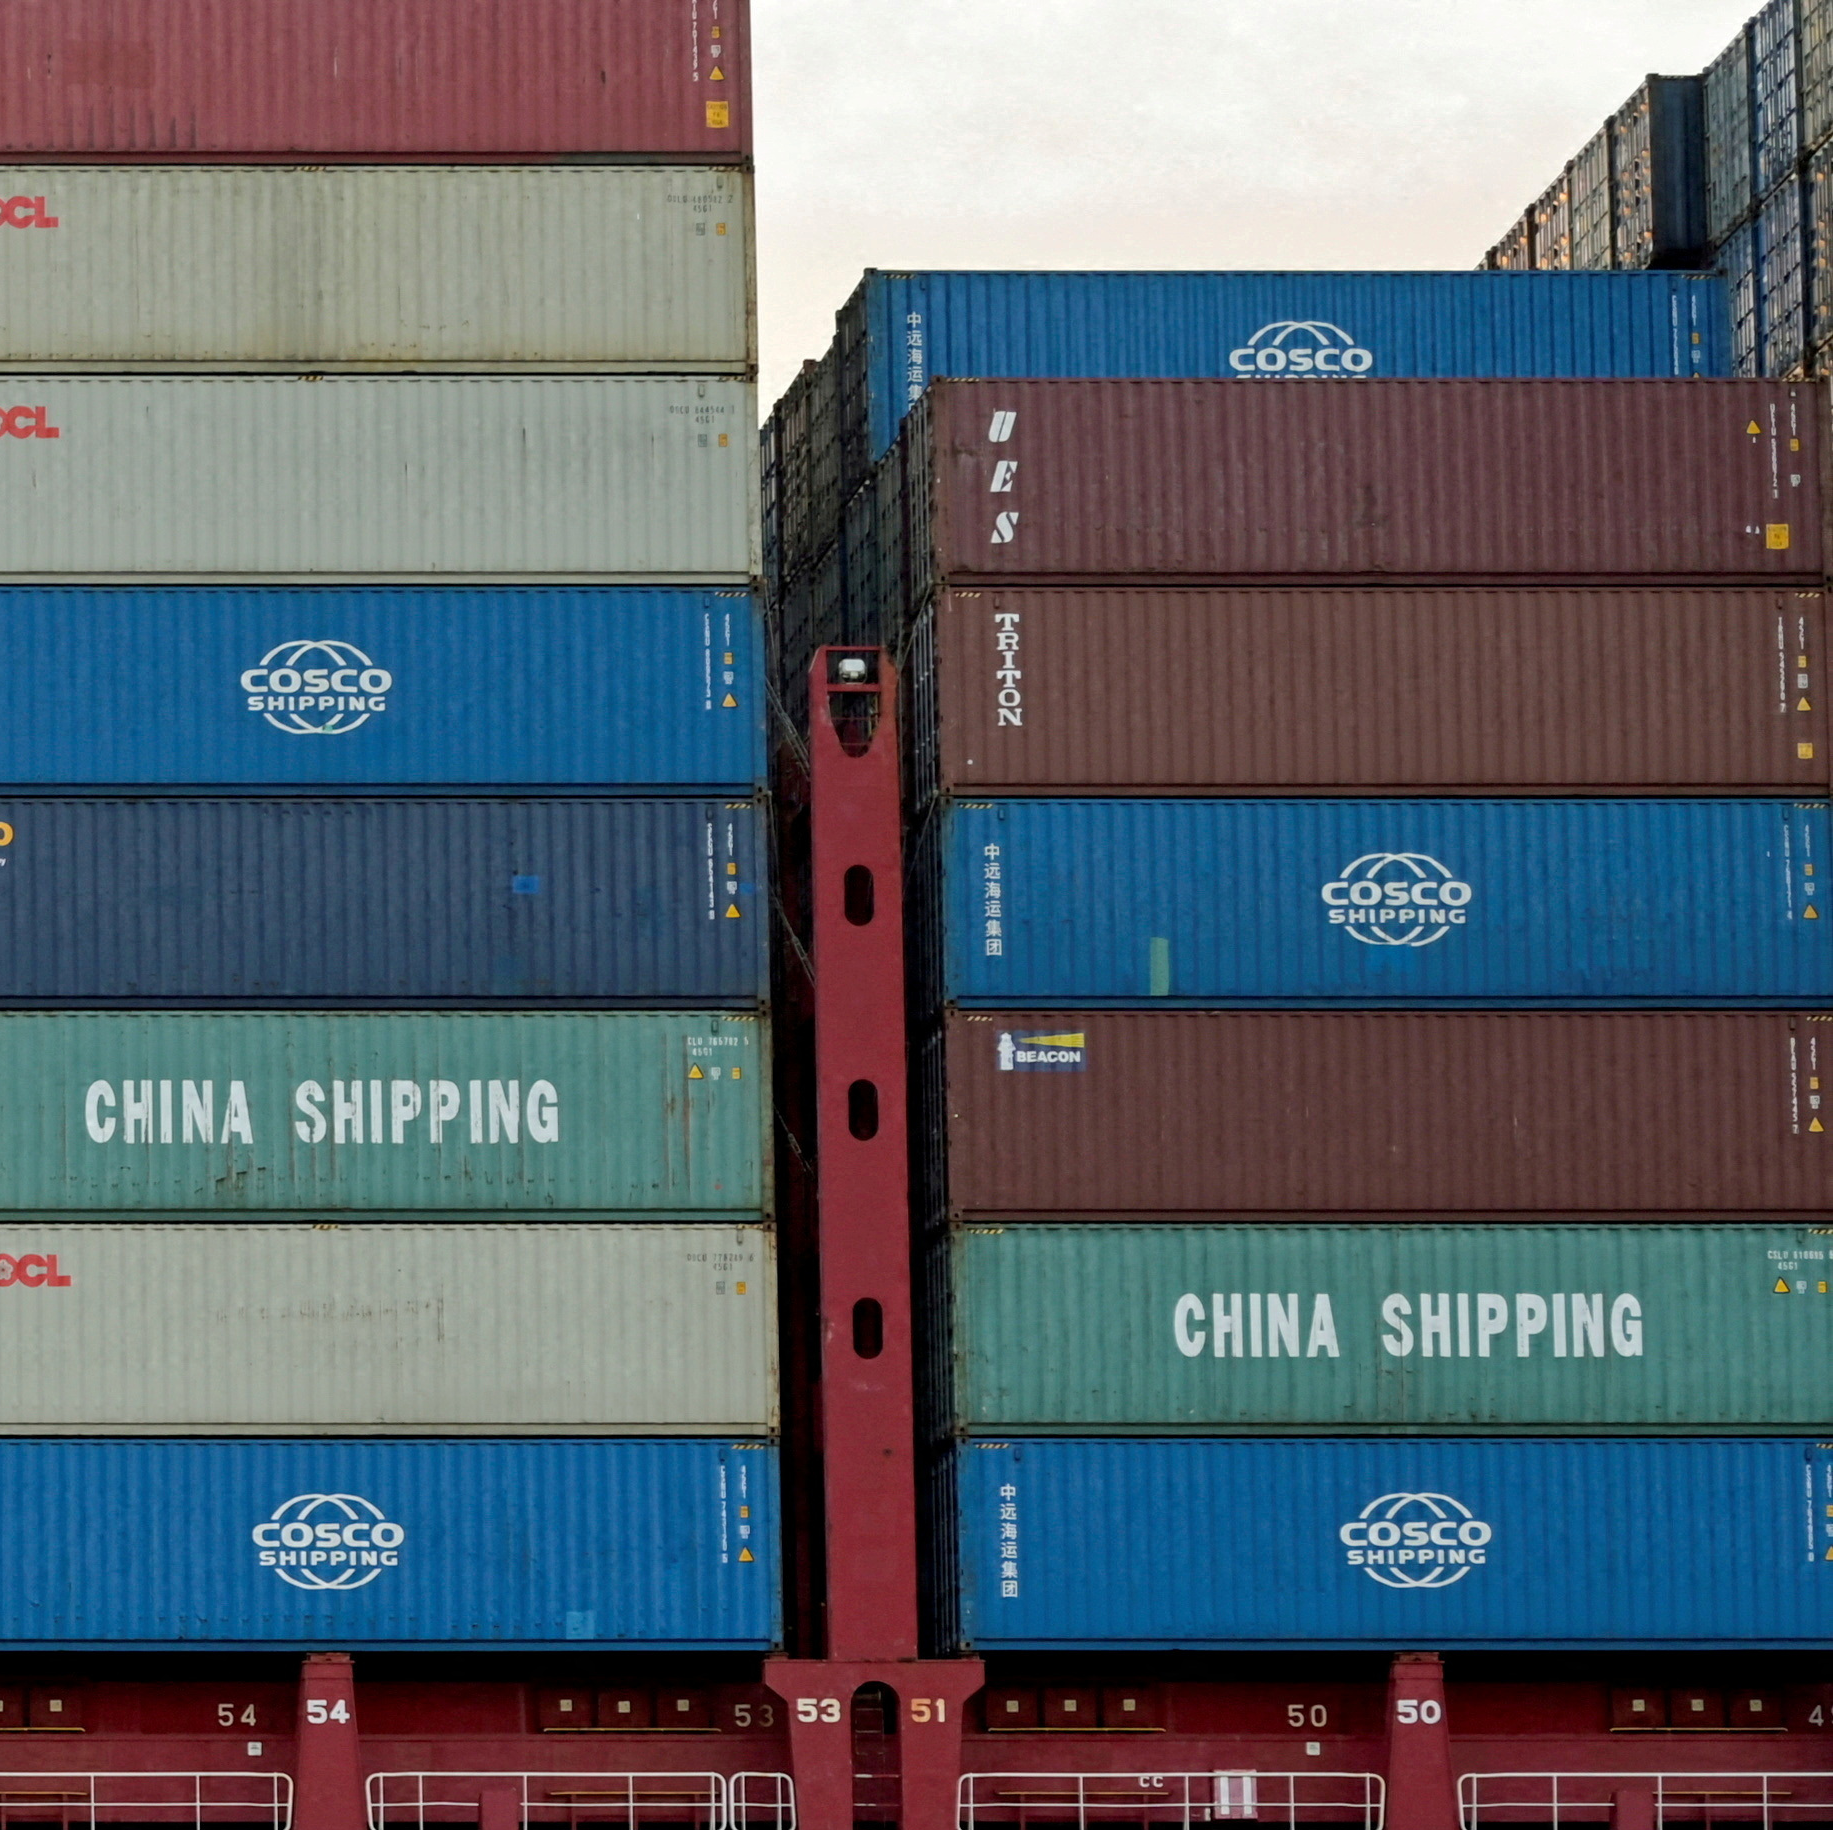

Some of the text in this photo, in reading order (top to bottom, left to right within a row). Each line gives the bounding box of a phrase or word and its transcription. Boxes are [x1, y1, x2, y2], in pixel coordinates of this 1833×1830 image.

[906, 312, 924, 411] 中远海运集
[1230, 348, 1372, 372] COSCO
[241, 668, 392, 694] COSCO
[995, 614, 1022, 725] TRITON
[248, 696, 386, 712] SHIPPING
[985, 843, 1001, 955] 中远海运集团
[1322, 881, 1471, 906] COSCO
[1329, 909, 1466, 924] SHIPPING
[1016, 1050, 1081, 1063] BEACON
[86, 1080, 558, 1144] CHINA SHIPPING
[1174, 1293, 1643, 1358] CHINA SHIPPING
[253, 1522, 404, 1547] COSCO
[1001, 1484, 1017, 1597] 中远海运集团
[1340, 1521, 1491, 1546] COSCO
[260, 1551, 397, 1565] SHIPPING
[1348, 1549, 1485, 1564] SHIPPING
[219, 1704, 256, 1726] 54
[307, 1700, 350, 1723] 54
[735, 1704, 773, 1726] 53
[797, 1699, 840, 1722] 53
[912, 1699, 945, 1722] 51
[1288, 1705, 1326, 1727] 50
[1398, 1700, 1440, 1724] 50
